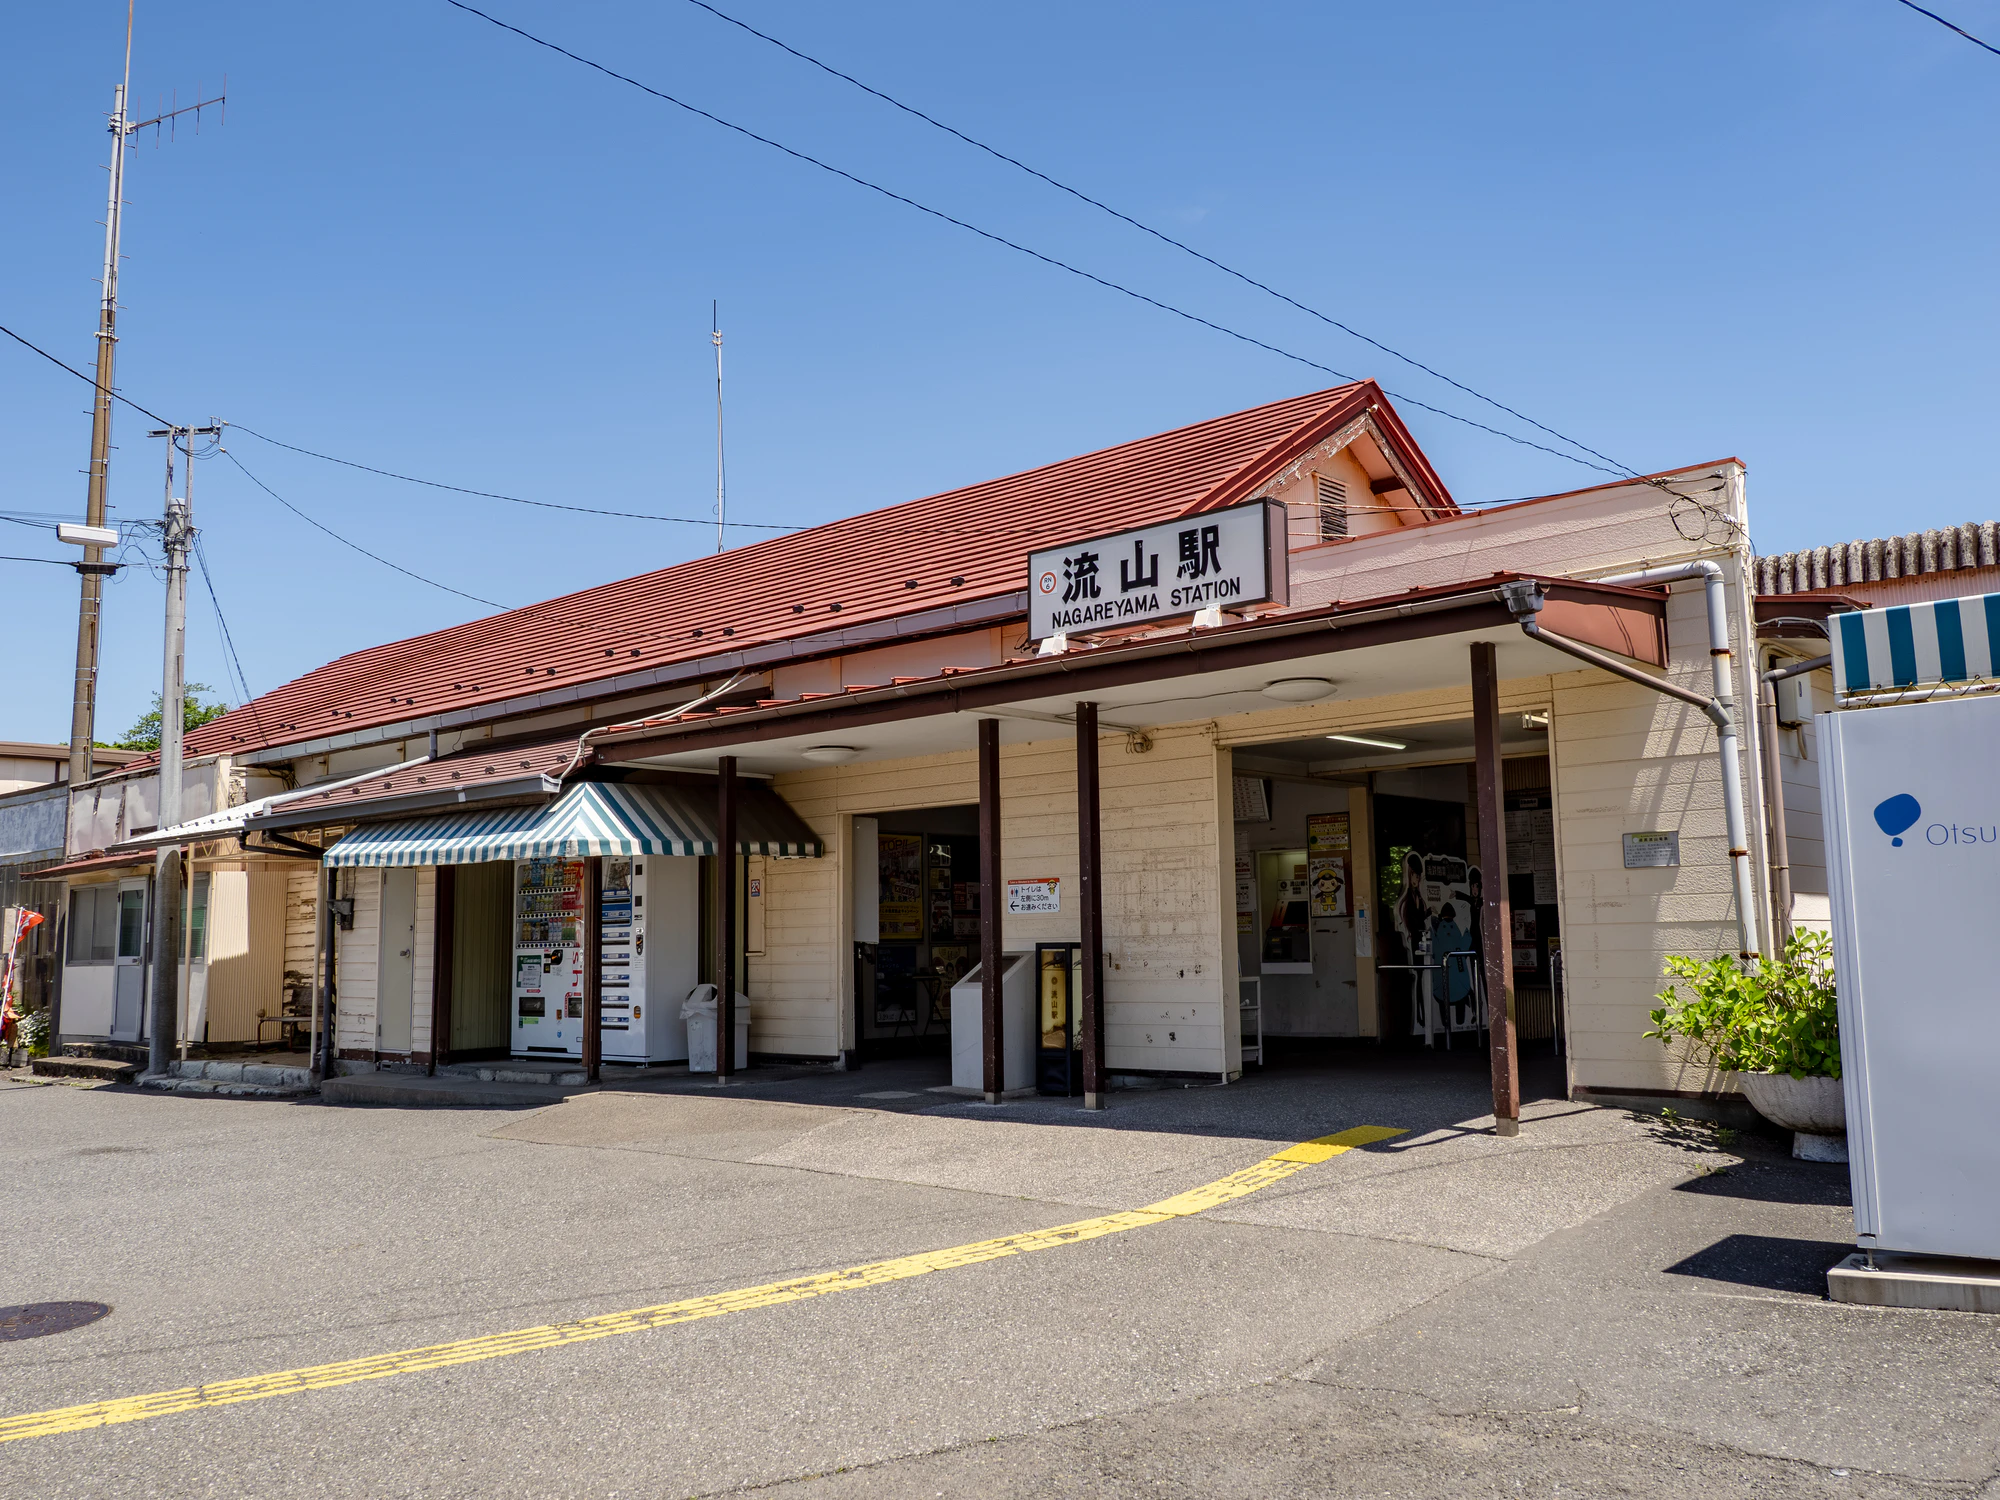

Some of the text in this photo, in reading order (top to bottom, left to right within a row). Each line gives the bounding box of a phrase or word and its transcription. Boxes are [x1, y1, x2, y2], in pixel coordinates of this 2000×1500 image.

[1061, 524, 1223, 604] 流山駅
[1051, 577, 1241, 630] NAGAREYAMA STATION
[1926, 823, 1997, 846] Otsu
[1020, 885, 1042, 893] トイレは
[1020, 894, 1050, 902] 左側に30m
[1020, 903, 1058, 911] お進みください
